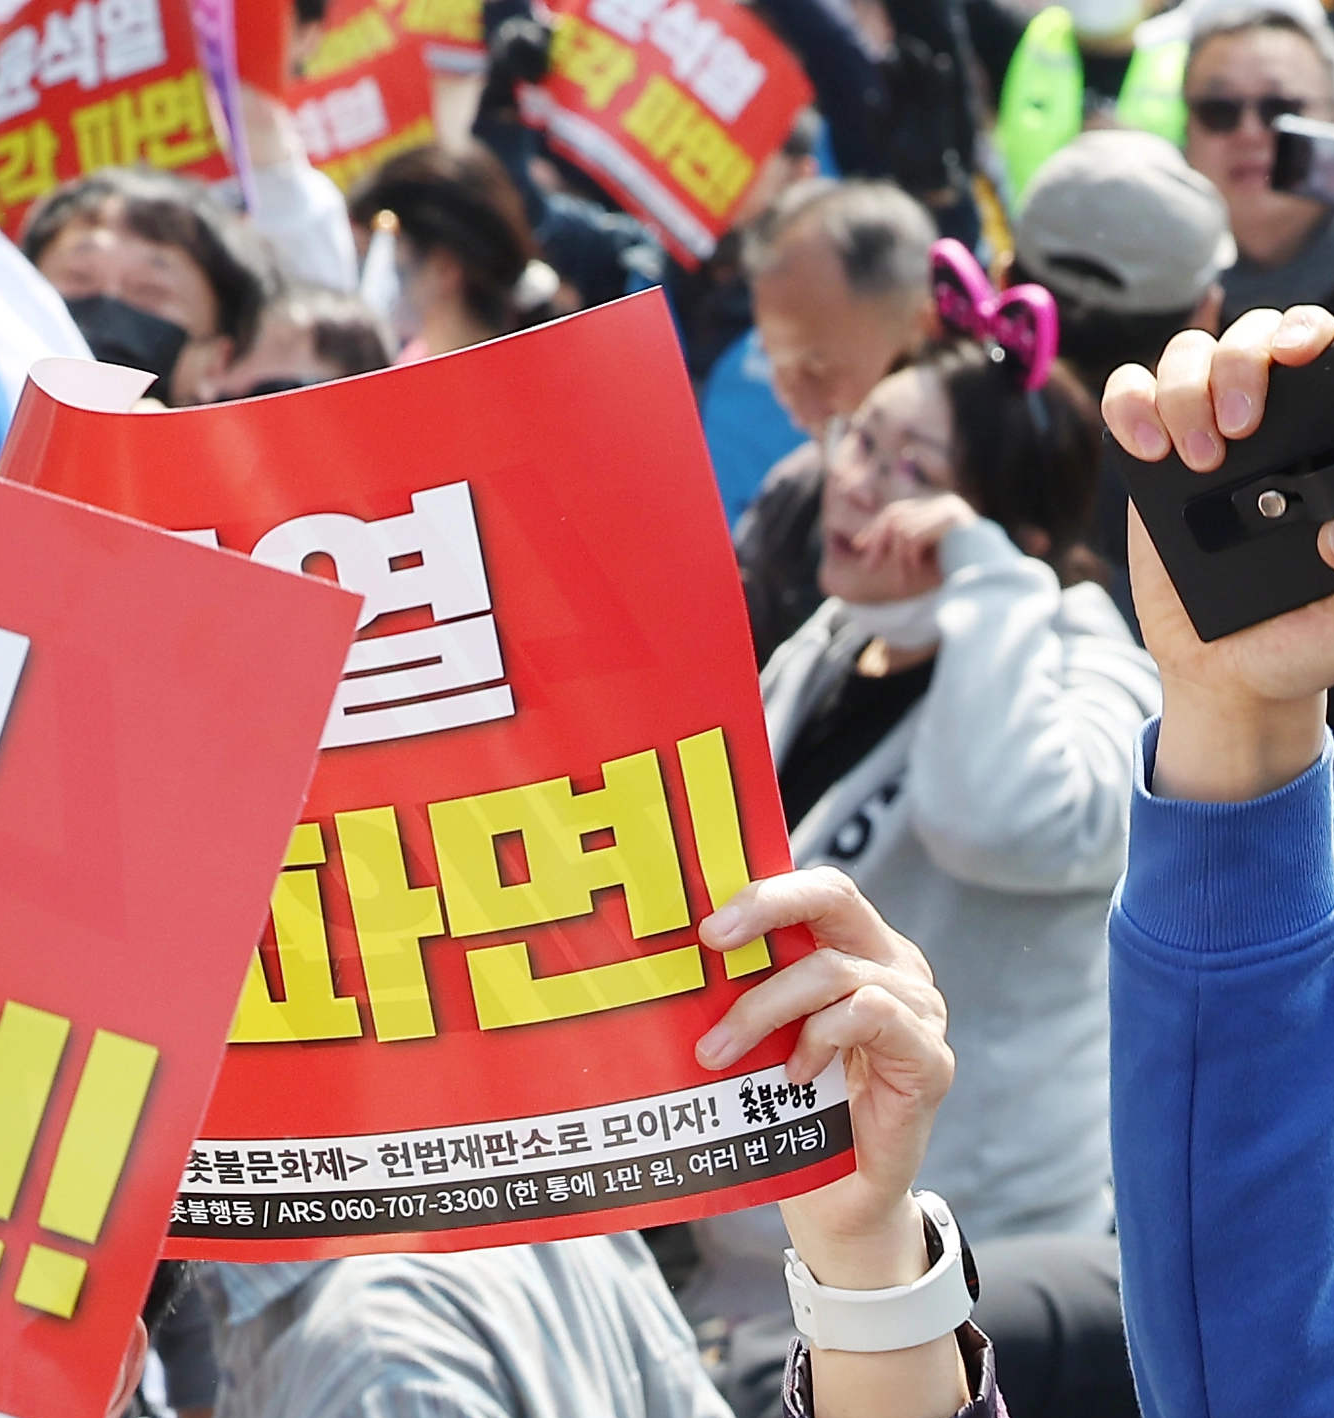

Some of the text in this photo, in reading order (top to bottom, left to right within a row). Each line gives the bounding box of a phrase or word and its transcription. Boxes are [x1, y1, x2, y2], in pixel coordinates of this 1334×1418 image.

[227, 726, 771, 1044] 파면!
[169, 1198, 255, 1226] 촛불행동
[277, 1200, 327, 1225] ARS
[330, 1186, 498, 1222] 060-707-3300
[504, 1179, 539, 1211] (한
[545, 1171, 597, 1203] 통에
[603, 1166, 643, 1194] 1만
[649, 1158, 685, 1186] 원,
[688, 1148, 739, 1177] 여러
[744, 1139, 769, 1167] 번
[773, 1118, 827, 1157] 가능)
[186, 1096, 721, 1185] 촛불문화제> 헌법재판소로 모이자!
